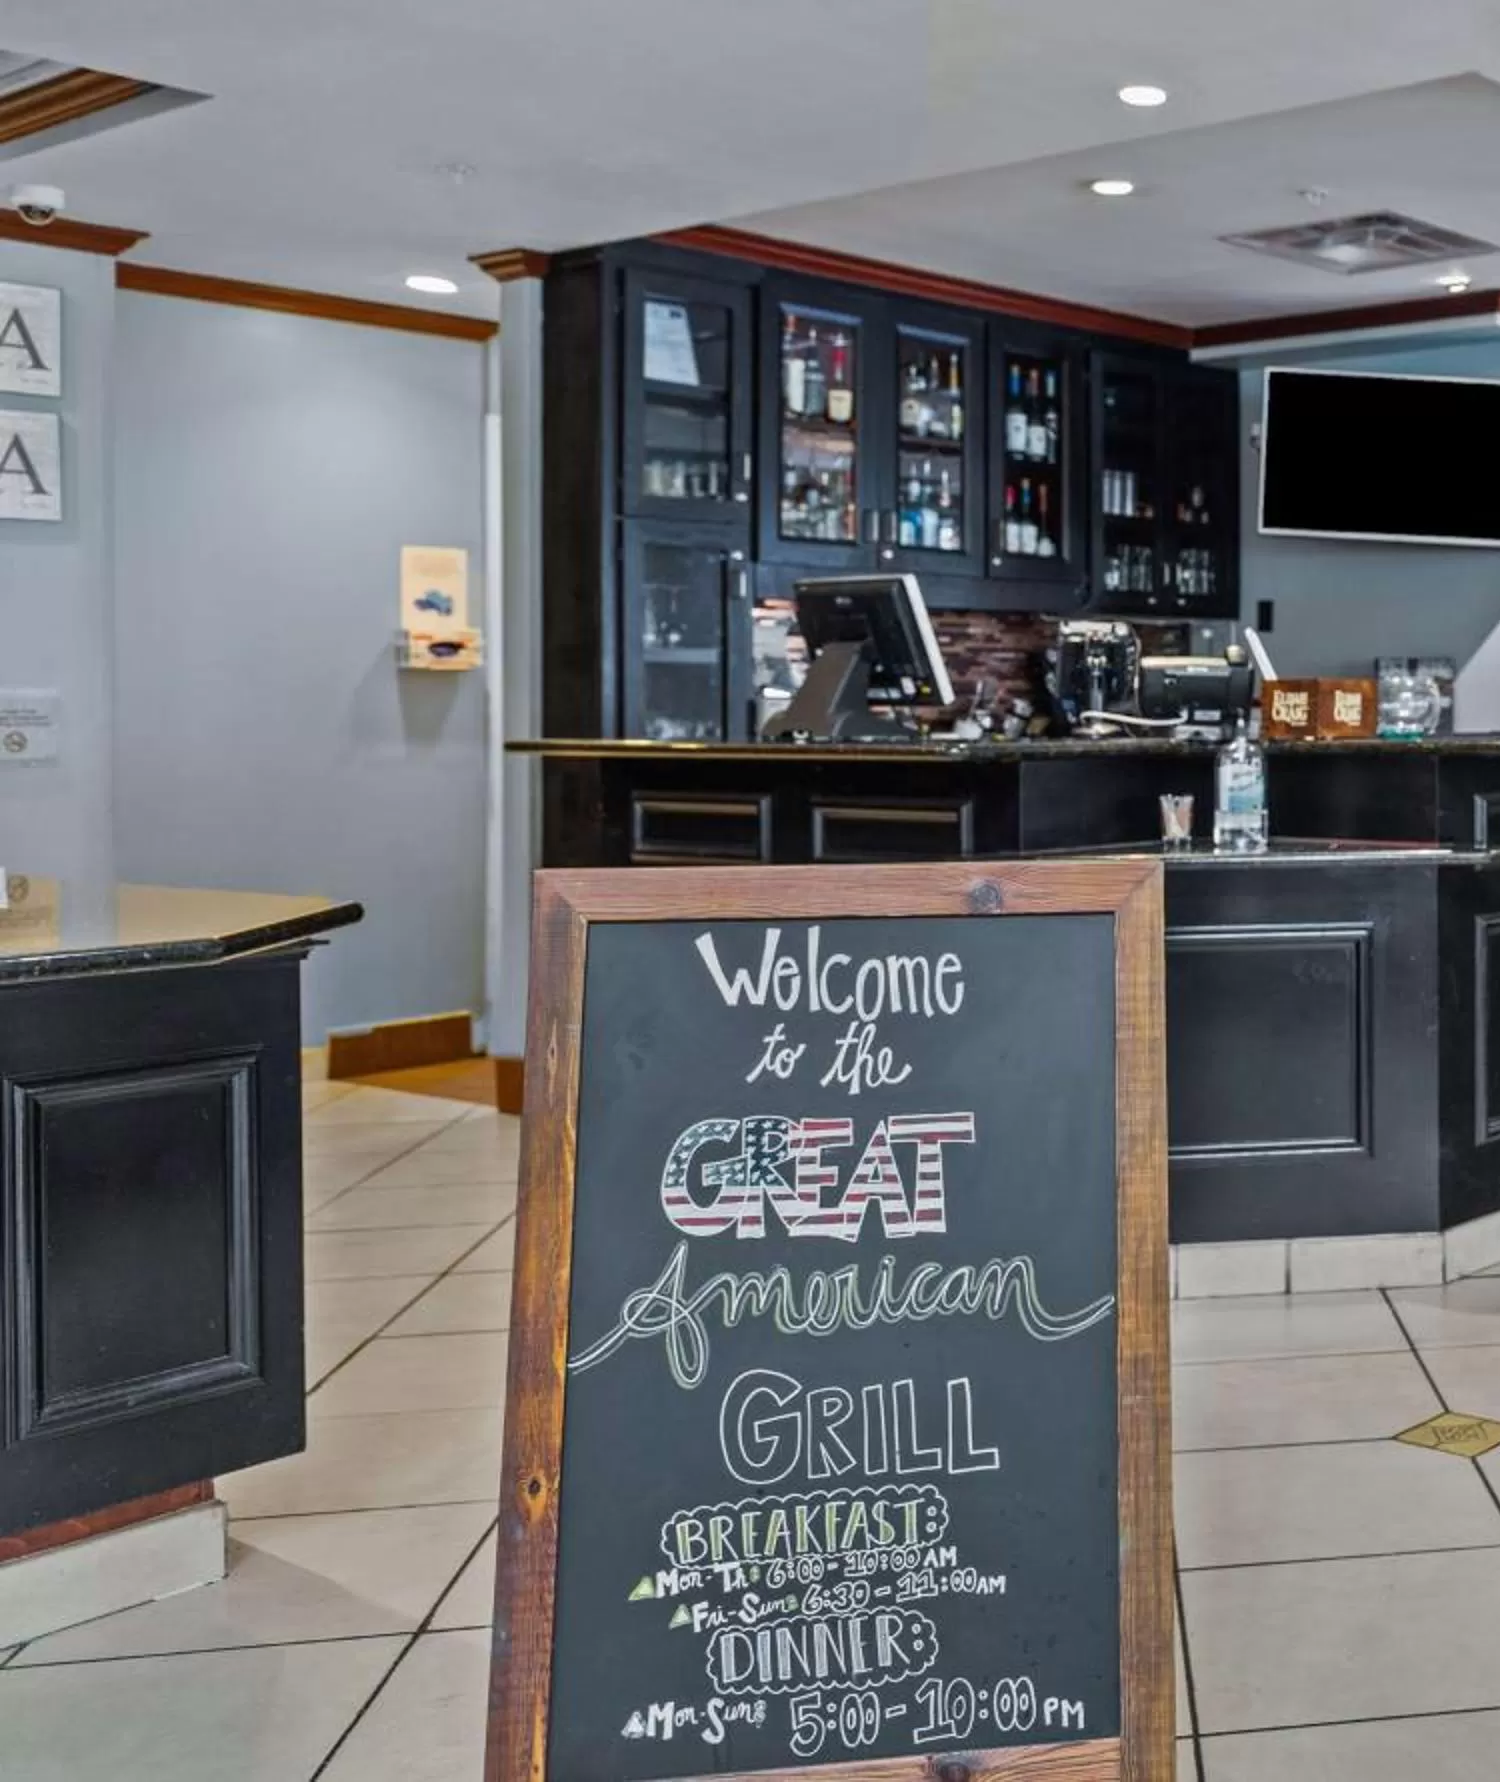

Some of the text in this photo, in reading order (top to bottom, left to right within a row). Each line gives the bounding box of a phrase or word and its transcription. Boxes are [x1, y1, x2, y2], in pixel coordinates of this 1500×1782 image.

[694, 925, 964, 1022] Welcome
[746, 1020, 912, 1095] to the
[660, 1111, 976, 1243] GREAT
[567, 1240, 1116, 1388] American
[719, 1369, 1000, 1485] GRILL
[674, 1498, 938, 1564] BREAKFAST:
[923, 1545, 958, 1569] AM
[719, 1614, 926, 1684] DINNER:
[1042, 1697, 1086, 1730] PM
